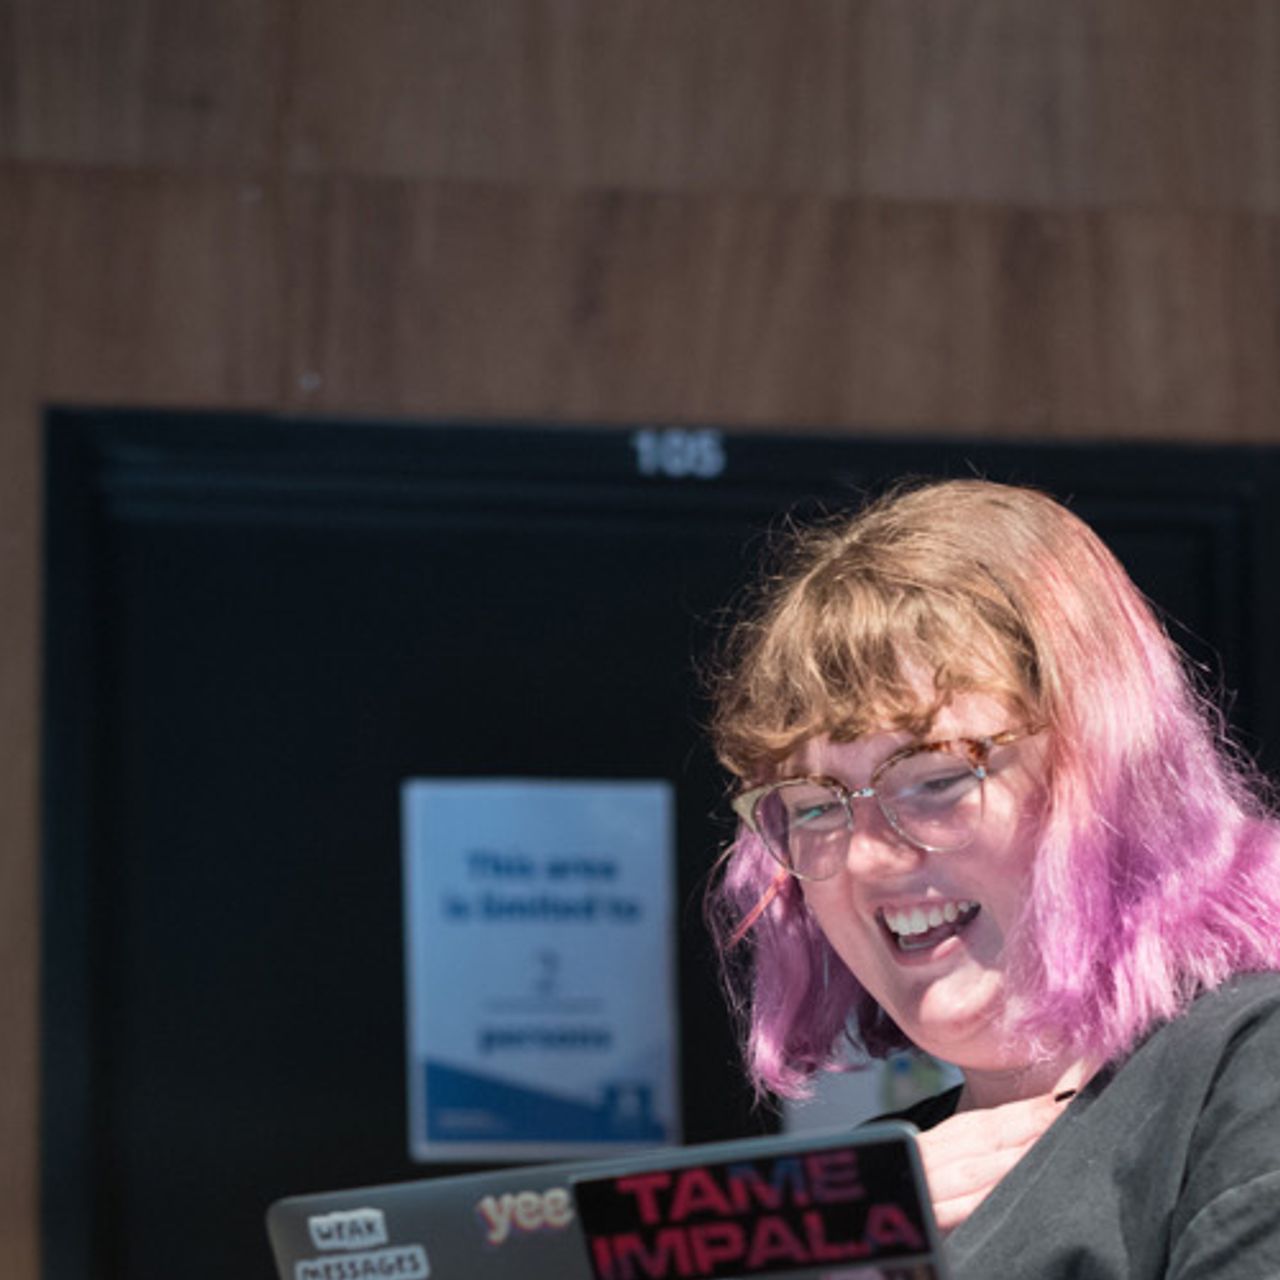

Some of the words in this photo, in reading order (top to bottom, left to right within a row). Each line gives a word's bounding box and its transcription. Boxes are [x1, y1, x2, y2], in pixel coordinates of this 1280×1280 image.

[467, 851, 533, 878] This
[615, 1150, 866, 1225] TAME
[316, 1216, 377, 1241] WEAK
[478, 1187, 573, 1245] yee
